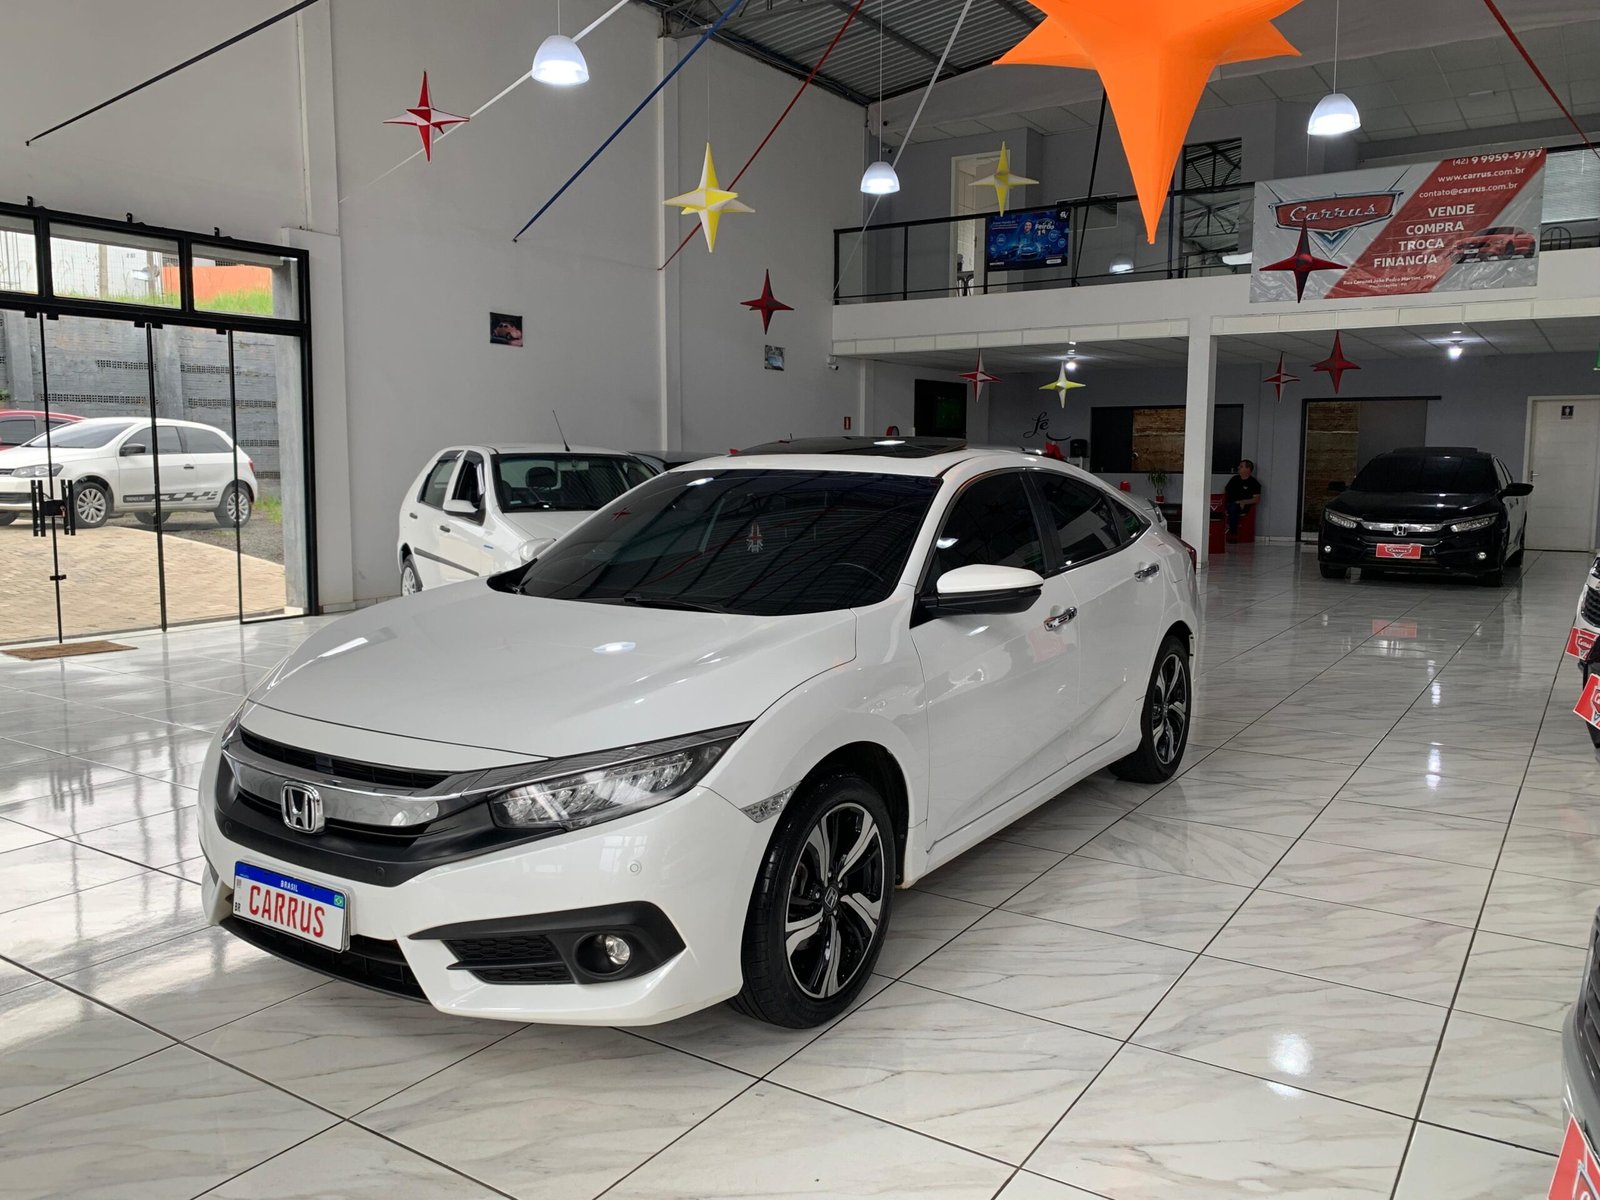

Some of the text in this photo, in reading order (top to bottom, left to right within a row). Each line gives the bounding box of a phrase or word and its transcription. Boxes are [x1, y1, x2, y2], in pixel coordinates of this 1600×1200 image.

[1452, 149, 1542, 167] (42) 9 9959-9797
[1437, 167, 1526, 183] www.carrus.com.br
[1418, 182, 1519, 198] contato@carrus.com.br
[1289, 204, 1378, 221] Carrus
[1428, 203, 1475, 218] VENDE
[1406, 221, 1464, 236] COMPRA
[1398, 238, 1445, 252] TROCA
[1373, 254, 1438, 269] FINANCIA
[280, 880, 299, 892] BRASIL
[249, 885, 325, 938] CARRUS
